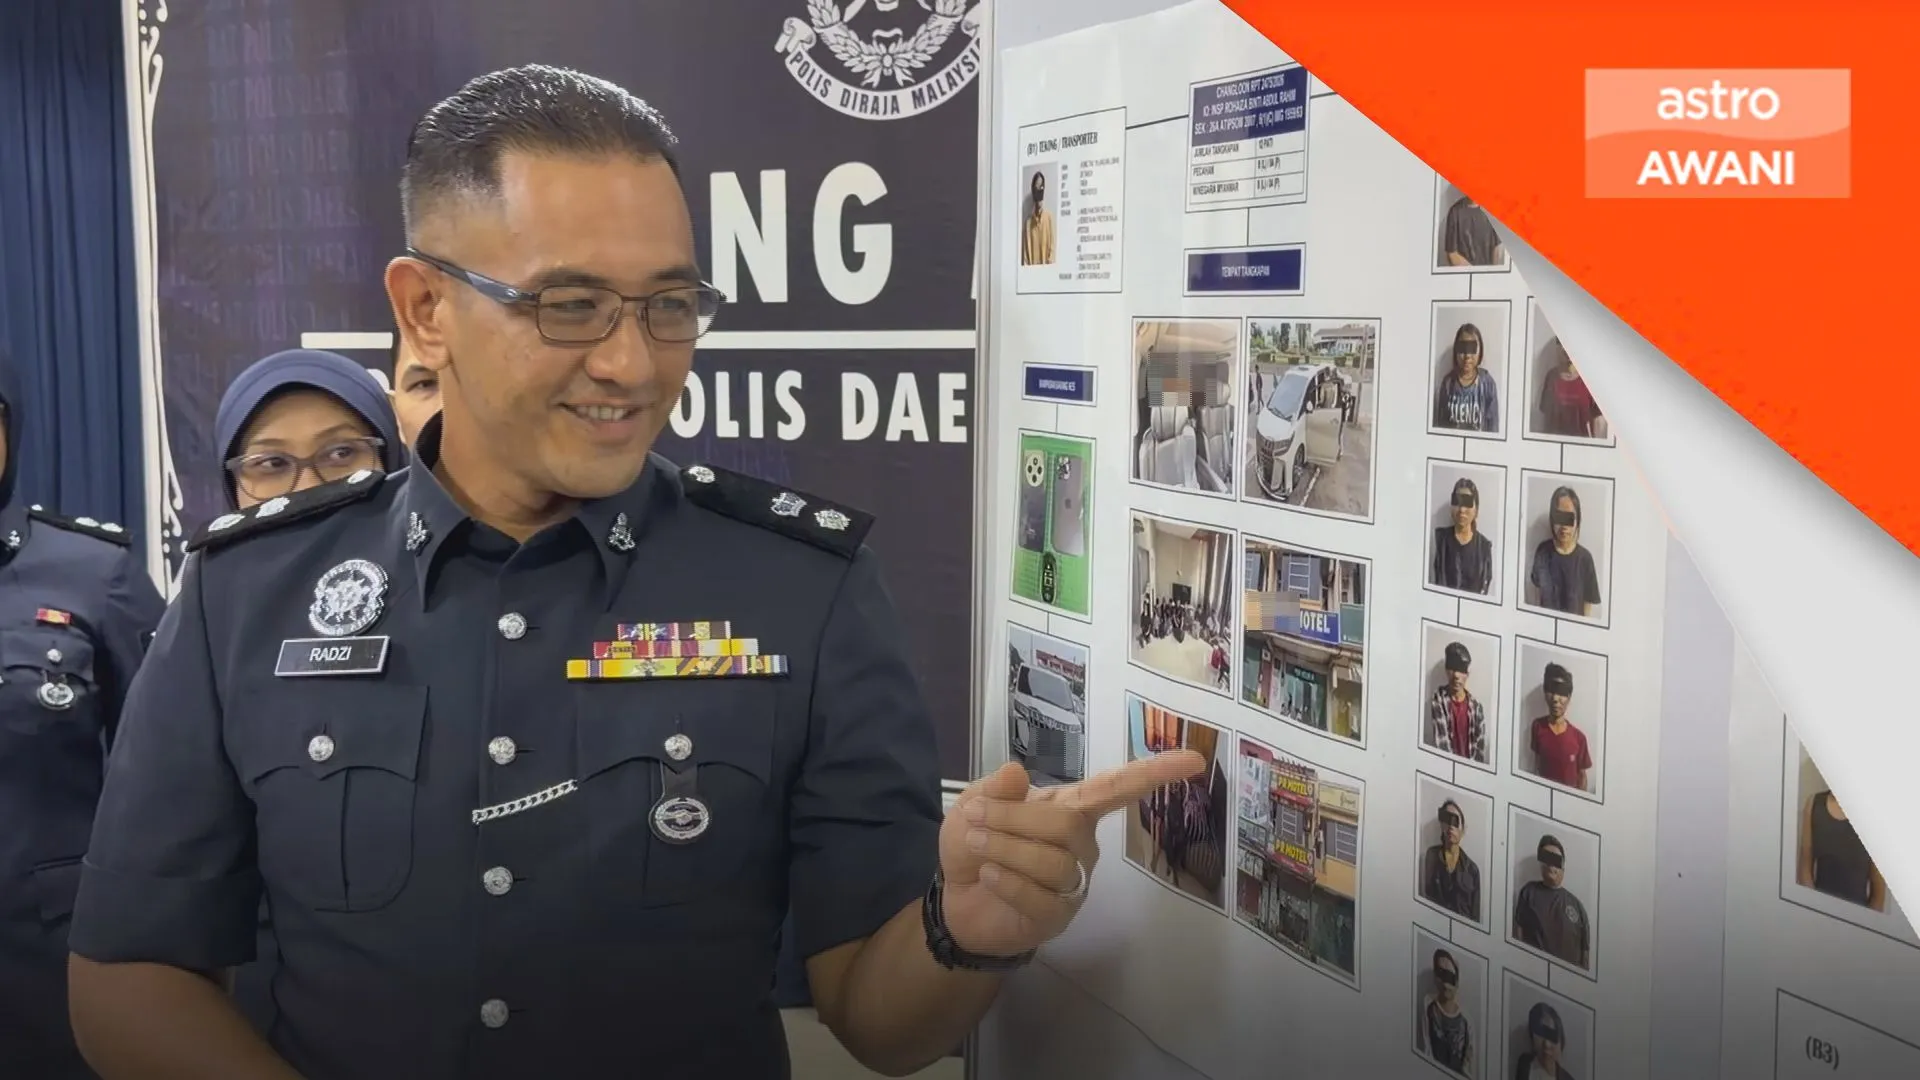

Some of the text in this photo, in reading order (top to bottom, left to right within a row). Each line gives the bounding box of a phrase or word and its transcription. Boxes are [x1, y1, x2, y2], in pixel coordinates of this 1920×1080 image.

[789, 51, 832, 98] POLIS
[839, 87, 901, 116] DIRAJA
[1061, 131, 1098, 148] TRANSPORTER
[309, 646, 352, 662] RADZI
[1285, 843, 1308, 865] MOTEL
[1806, 1036, 1839, 1070] (B3)
